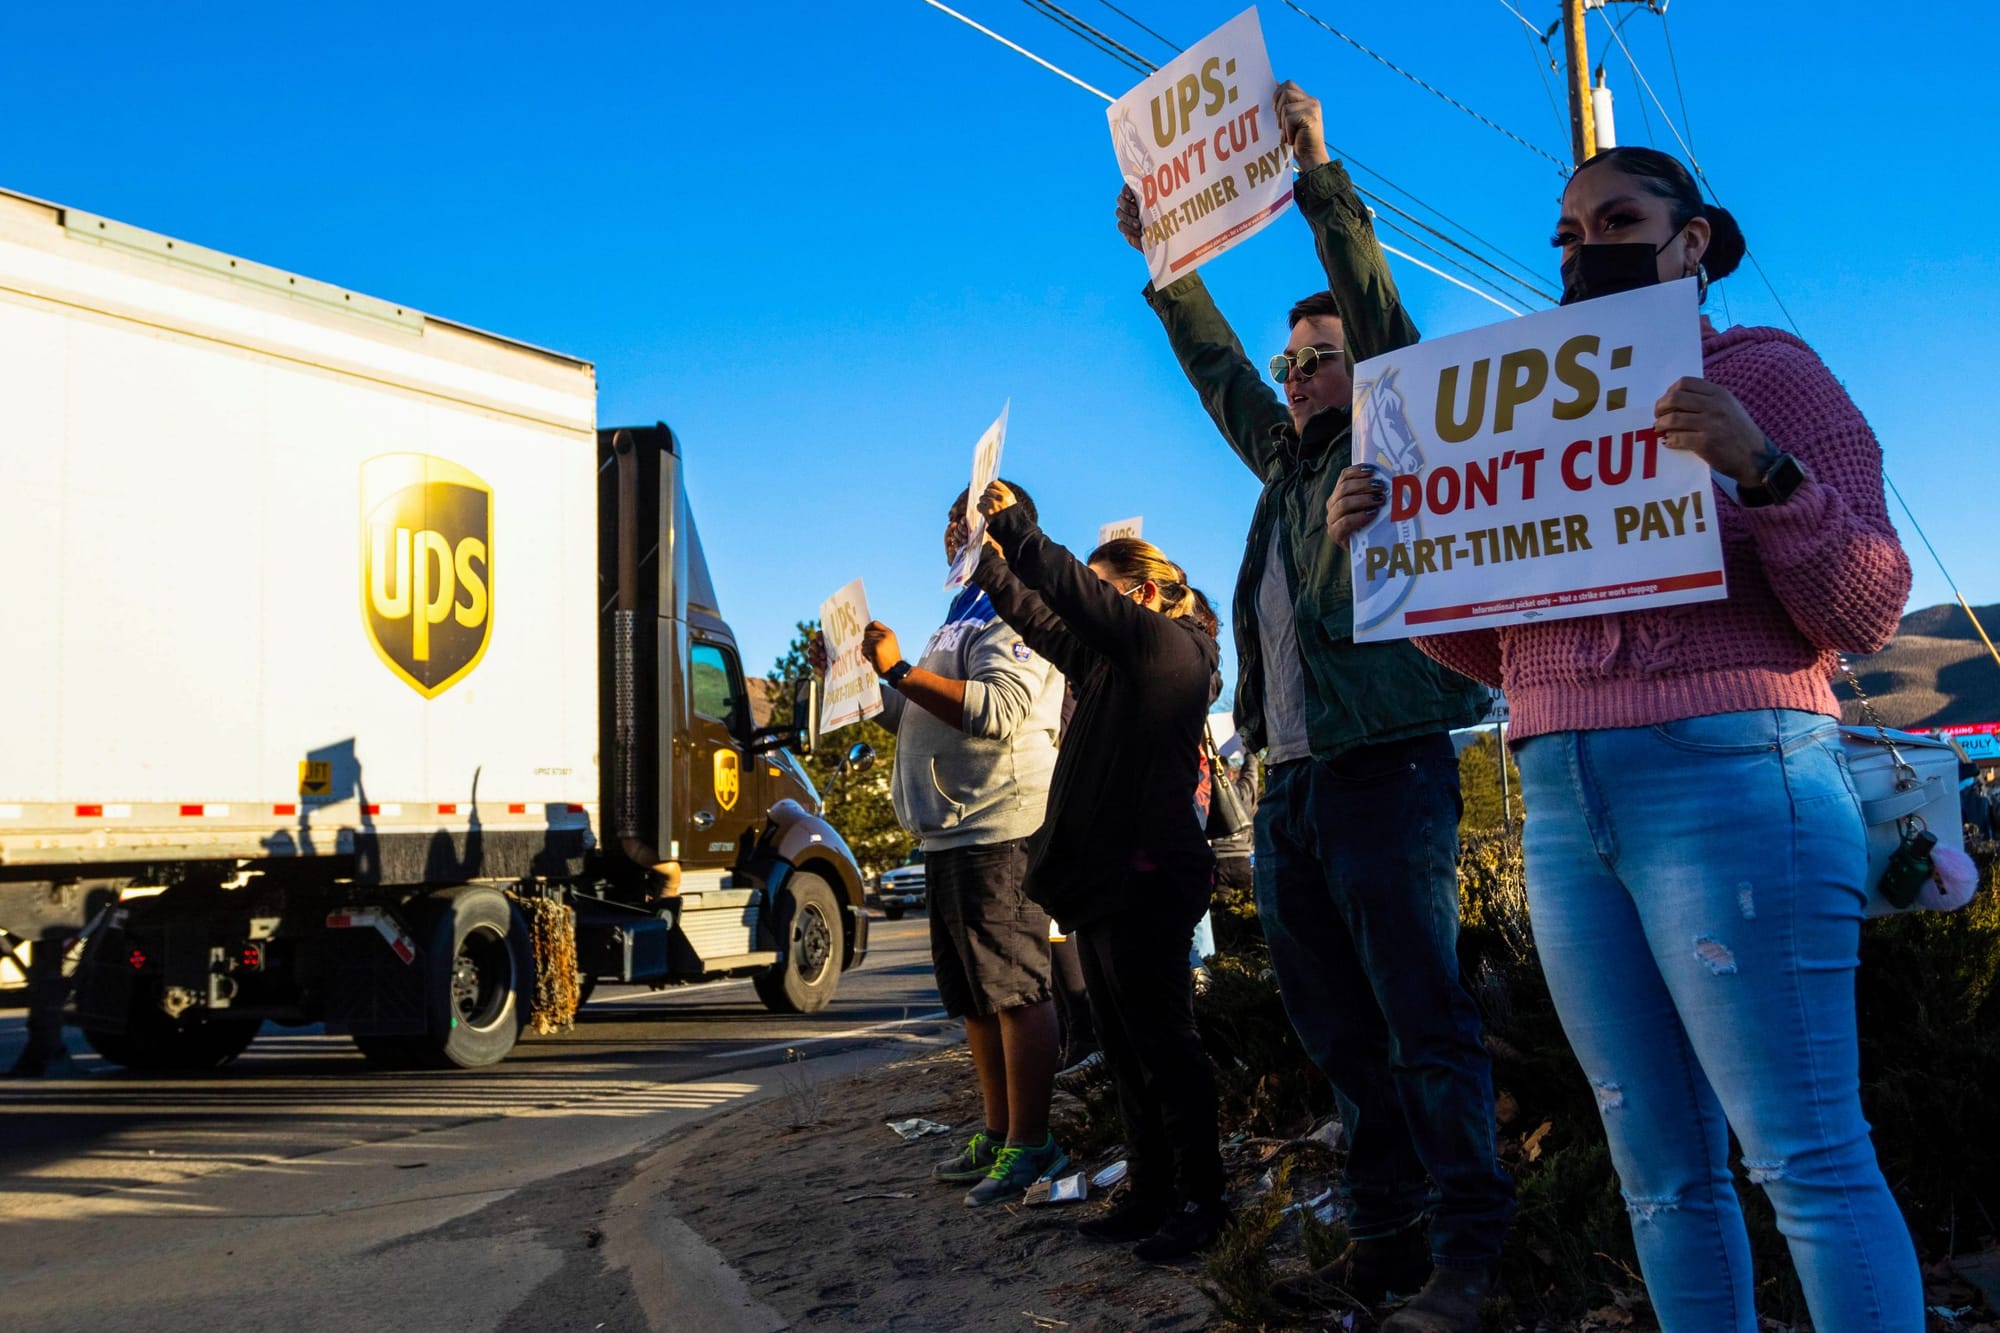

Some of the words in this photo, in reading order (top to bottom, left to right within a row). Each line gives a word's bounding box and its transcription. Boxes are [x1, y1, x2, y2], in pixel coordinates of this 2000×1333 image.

[1150, 57, 1238, 148] UPS:
[1141, 138, 1206, 209] DON'T
[1213, 104, 1259, 162] CUT
[1143, 175, 1239, 249] PART-TIMER
[1244, 143, 1290, 189] PAY!
[1434, 335, 1633, 443] UPS:
[1390, 448, 1544, 523] DON'T
[1560, 427, 1666, 492] CUT
[1365, 514, 1592, 581] PART-TIMER
[1614, 491, 1706, 545] PAY!
[371, 525, 487, 661] ups
[830, 601, 860, 646] UPS:
[1472, 601, 1515, 615] Informational
[1516, 600, 1536, 610] picket
[1537, 597, 1551, 607] only
[1560, 594, 1571, 602] Not
[1579, 592, 1598, 600] strike
[1608, 587, 1626, 596] work
[1627, 585, 1658, 594] stoppage
[718, 767, 736, 801] ups
[1961, 738, 1991, 749] RULY
